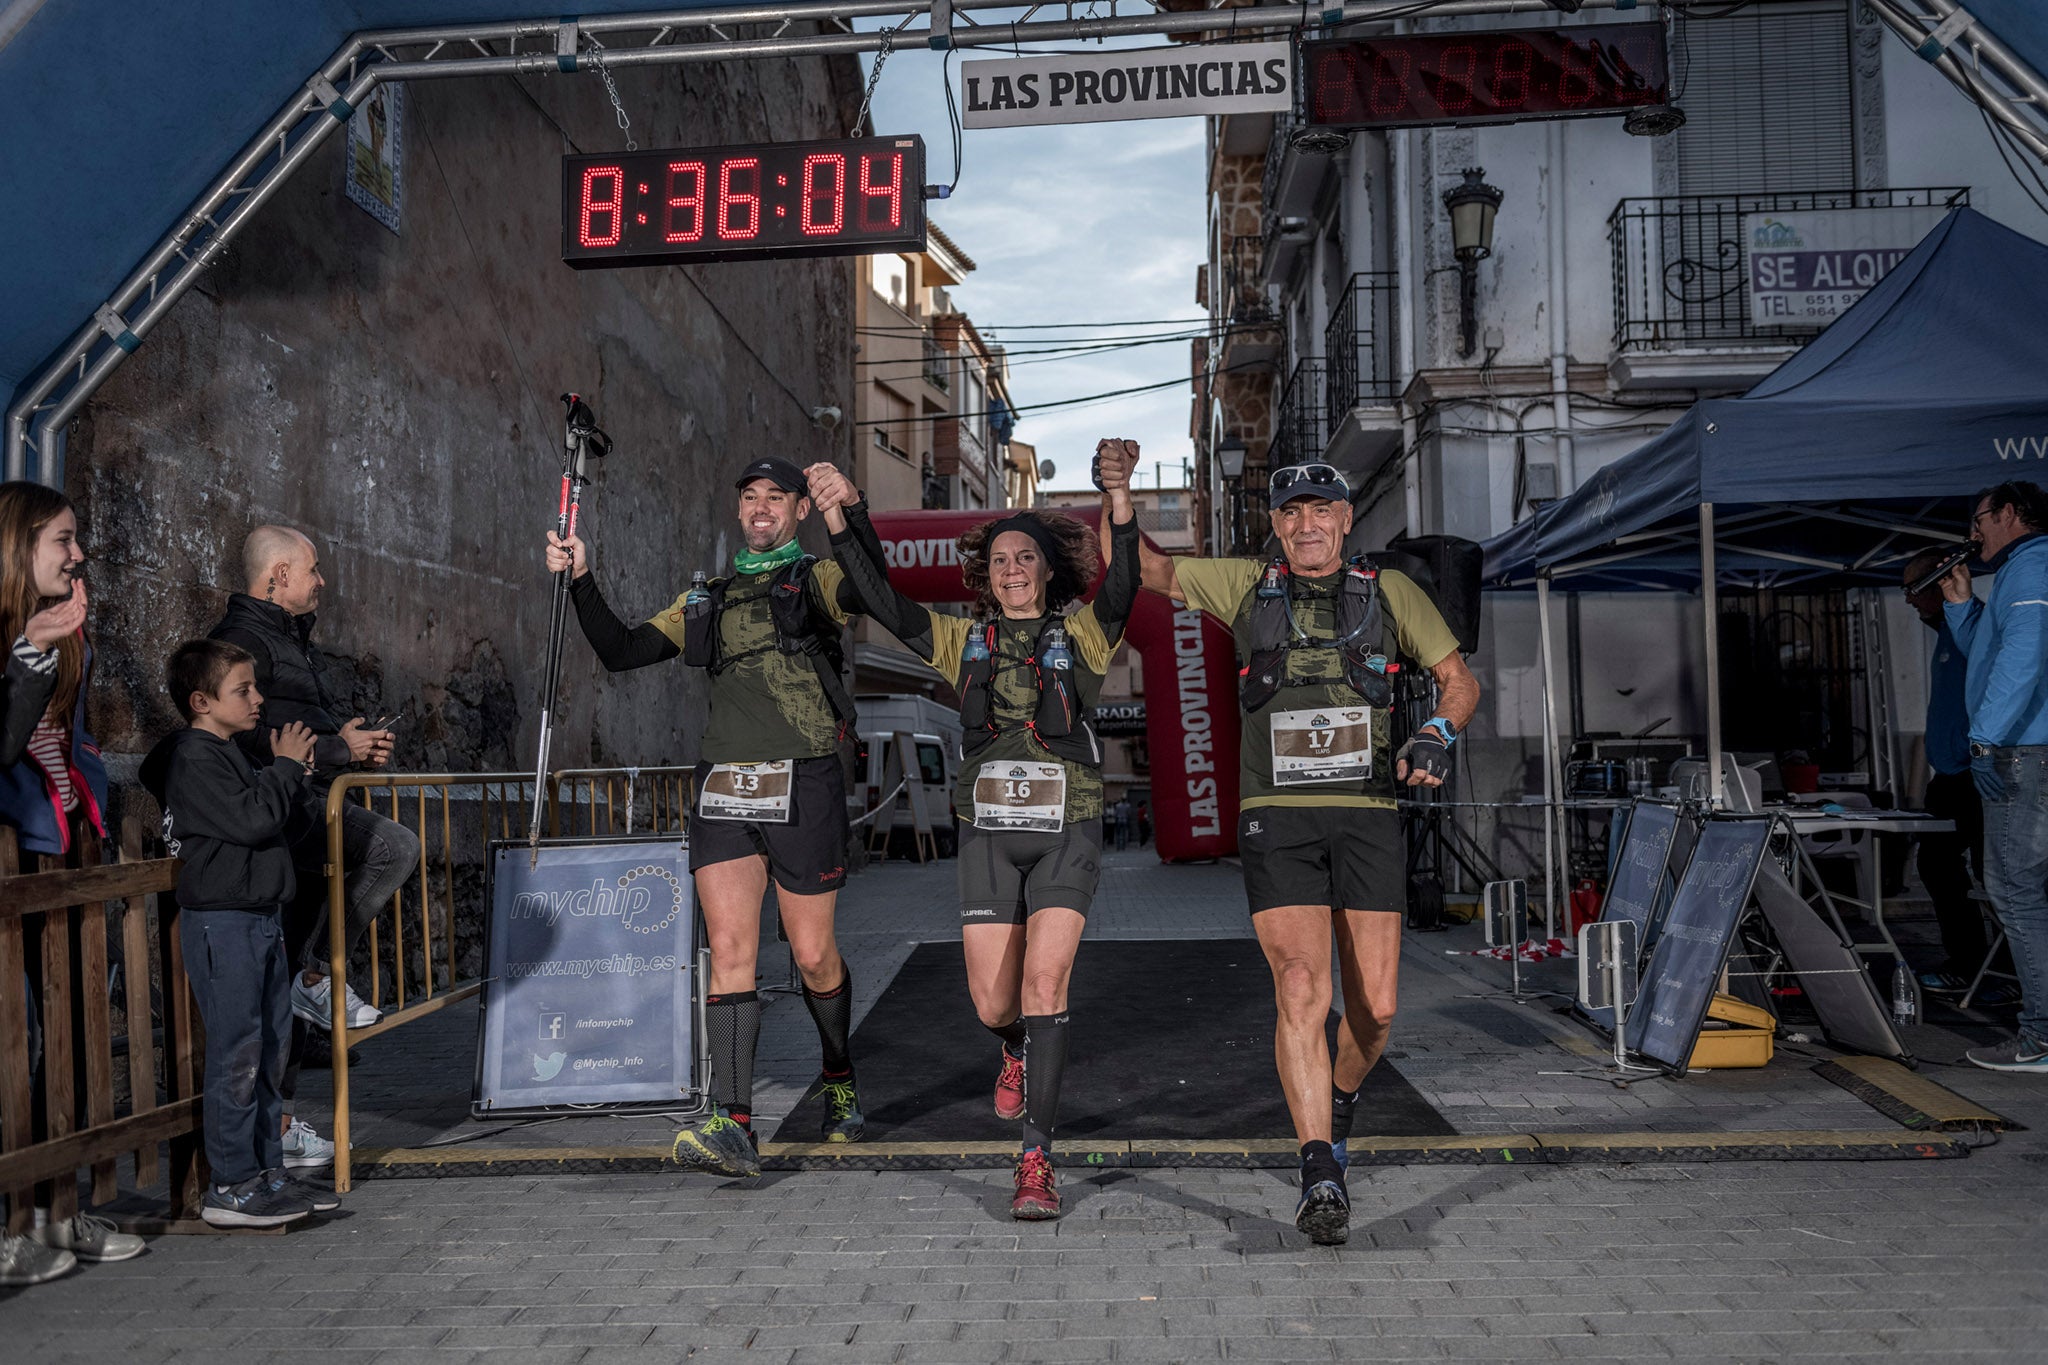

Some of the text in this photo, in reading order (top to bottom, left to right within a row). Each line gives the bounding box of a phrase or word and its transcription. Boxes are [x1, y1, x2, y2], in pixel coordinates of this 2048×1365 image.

[967, 73, 1040, 112] LAS
[1048, 58, 1287, 107] PROVINCIAS
[579, 152, 903, 248] 8:36:04
[1758, 252, 1904, 289] SE ALQU
[1805, 295, 1835, 305] 651
[1806, 306, 1838, 317] 964
[1307, 730, 1335, 749] 17
[733, 773, 759, 791] 13
[1005, 780, 1031, 798] 16
[1187, 778, 1222, 838] LAS
[510, 878, 651, 927] mychip
[506, 952, 676, 980] www.mychip.es
[575, 1016, 634, 1030] /infomychip
[572, 1055, 644, 1071] @Mychip_Info
